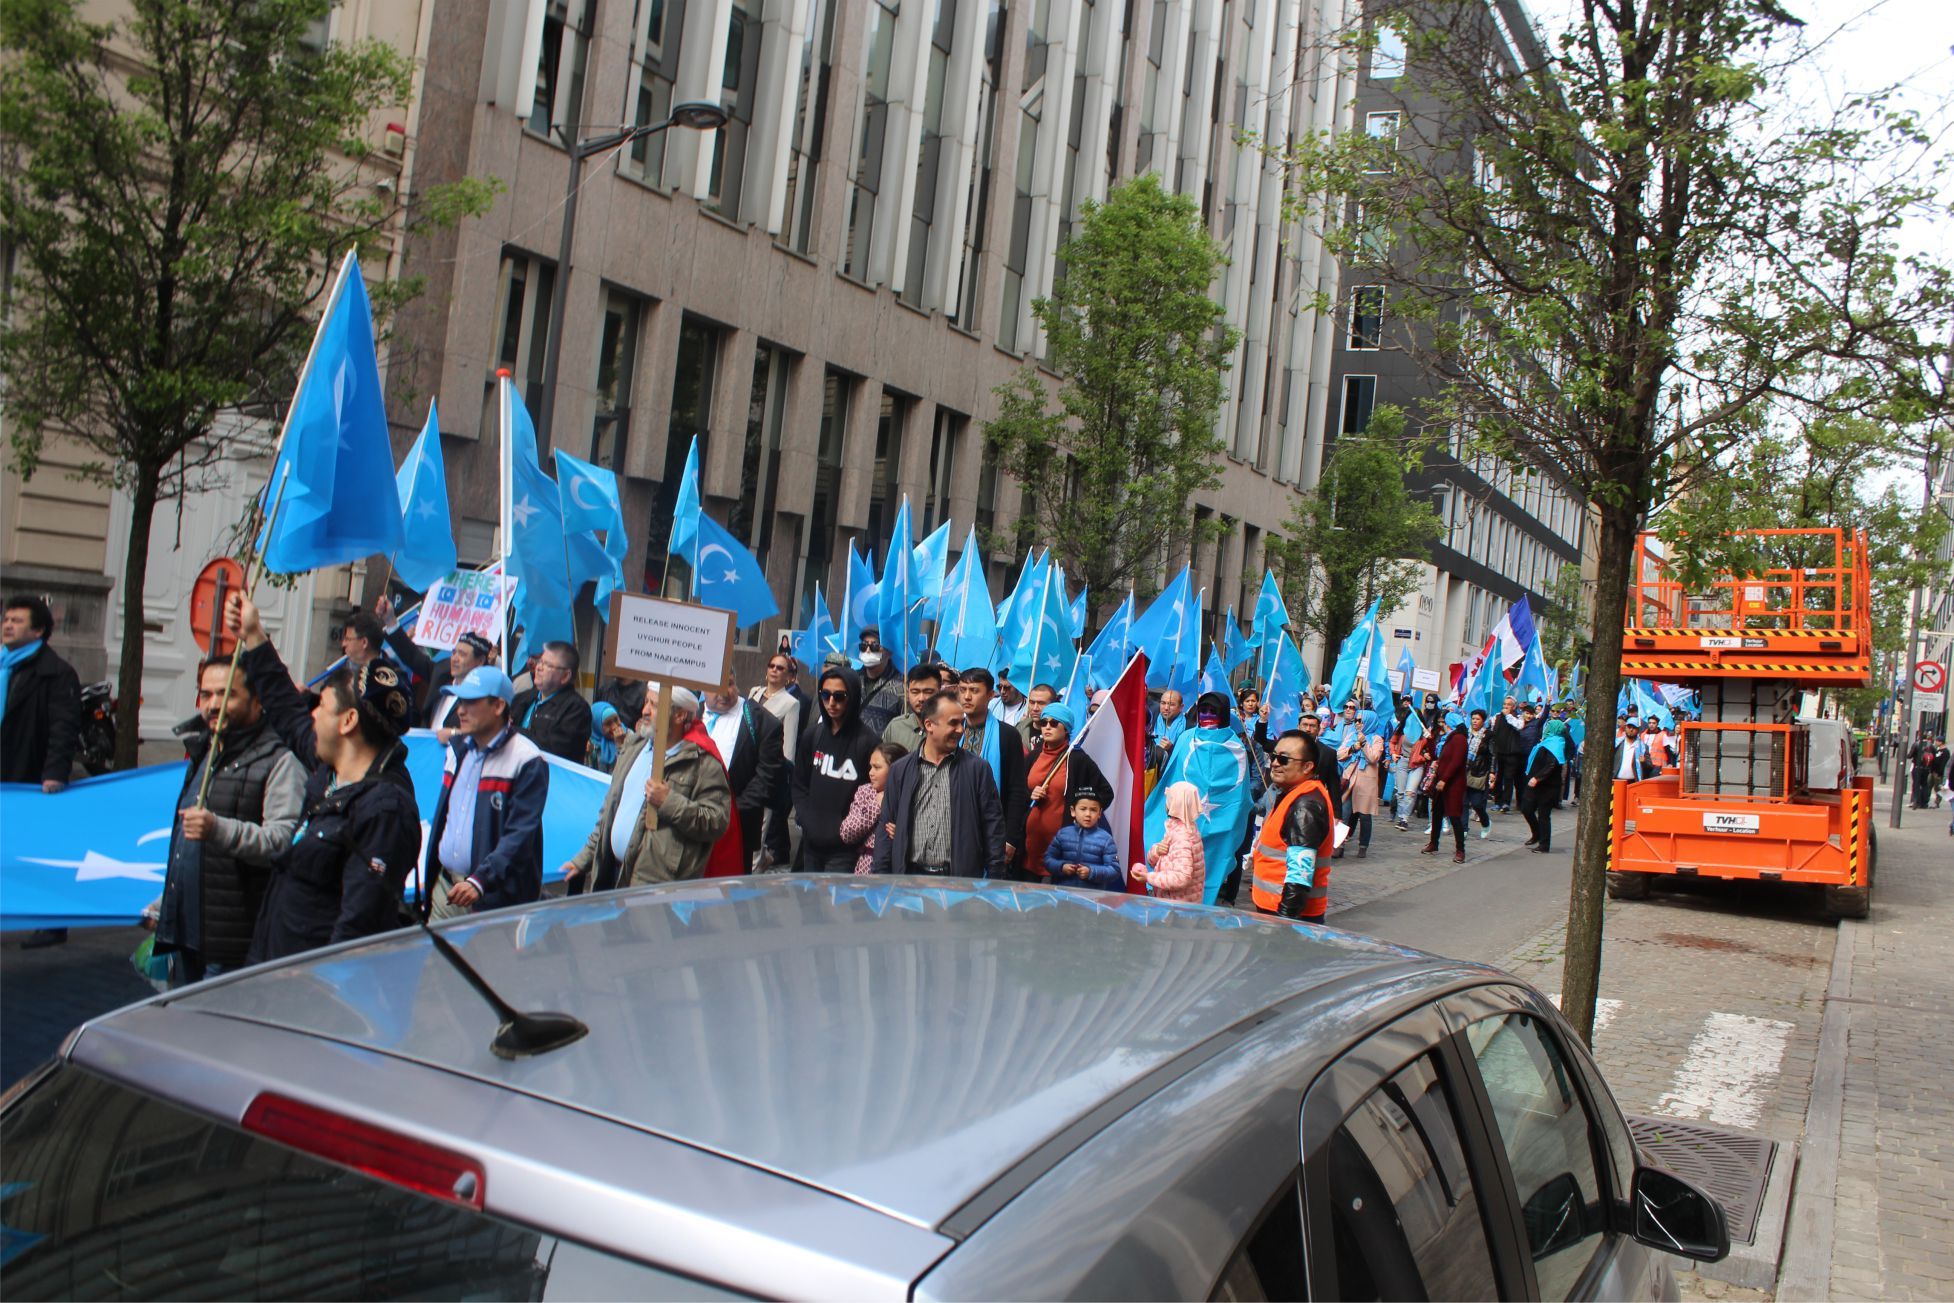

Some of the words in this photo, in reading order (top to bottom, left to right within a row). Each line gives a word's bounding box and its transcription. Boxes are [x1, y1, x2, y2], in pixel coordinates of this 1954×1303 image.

[429, 603, 494, 629] HUMANS
[633, 615, 669, 628] RELEASE
[671, 622, 711, 635] INNOCENT
[637, 633, 670, 645] UYGHUR
[672, 640, 702, 651] PEOPLE
[630, 648, 652, 658] FROM
[654, 652, 672, 662] NAZI
[673, 656, 706, 668] CAMPUS
[813, 750, 858, 781] FILA
[1716, 816, 1736, 825] TVH
